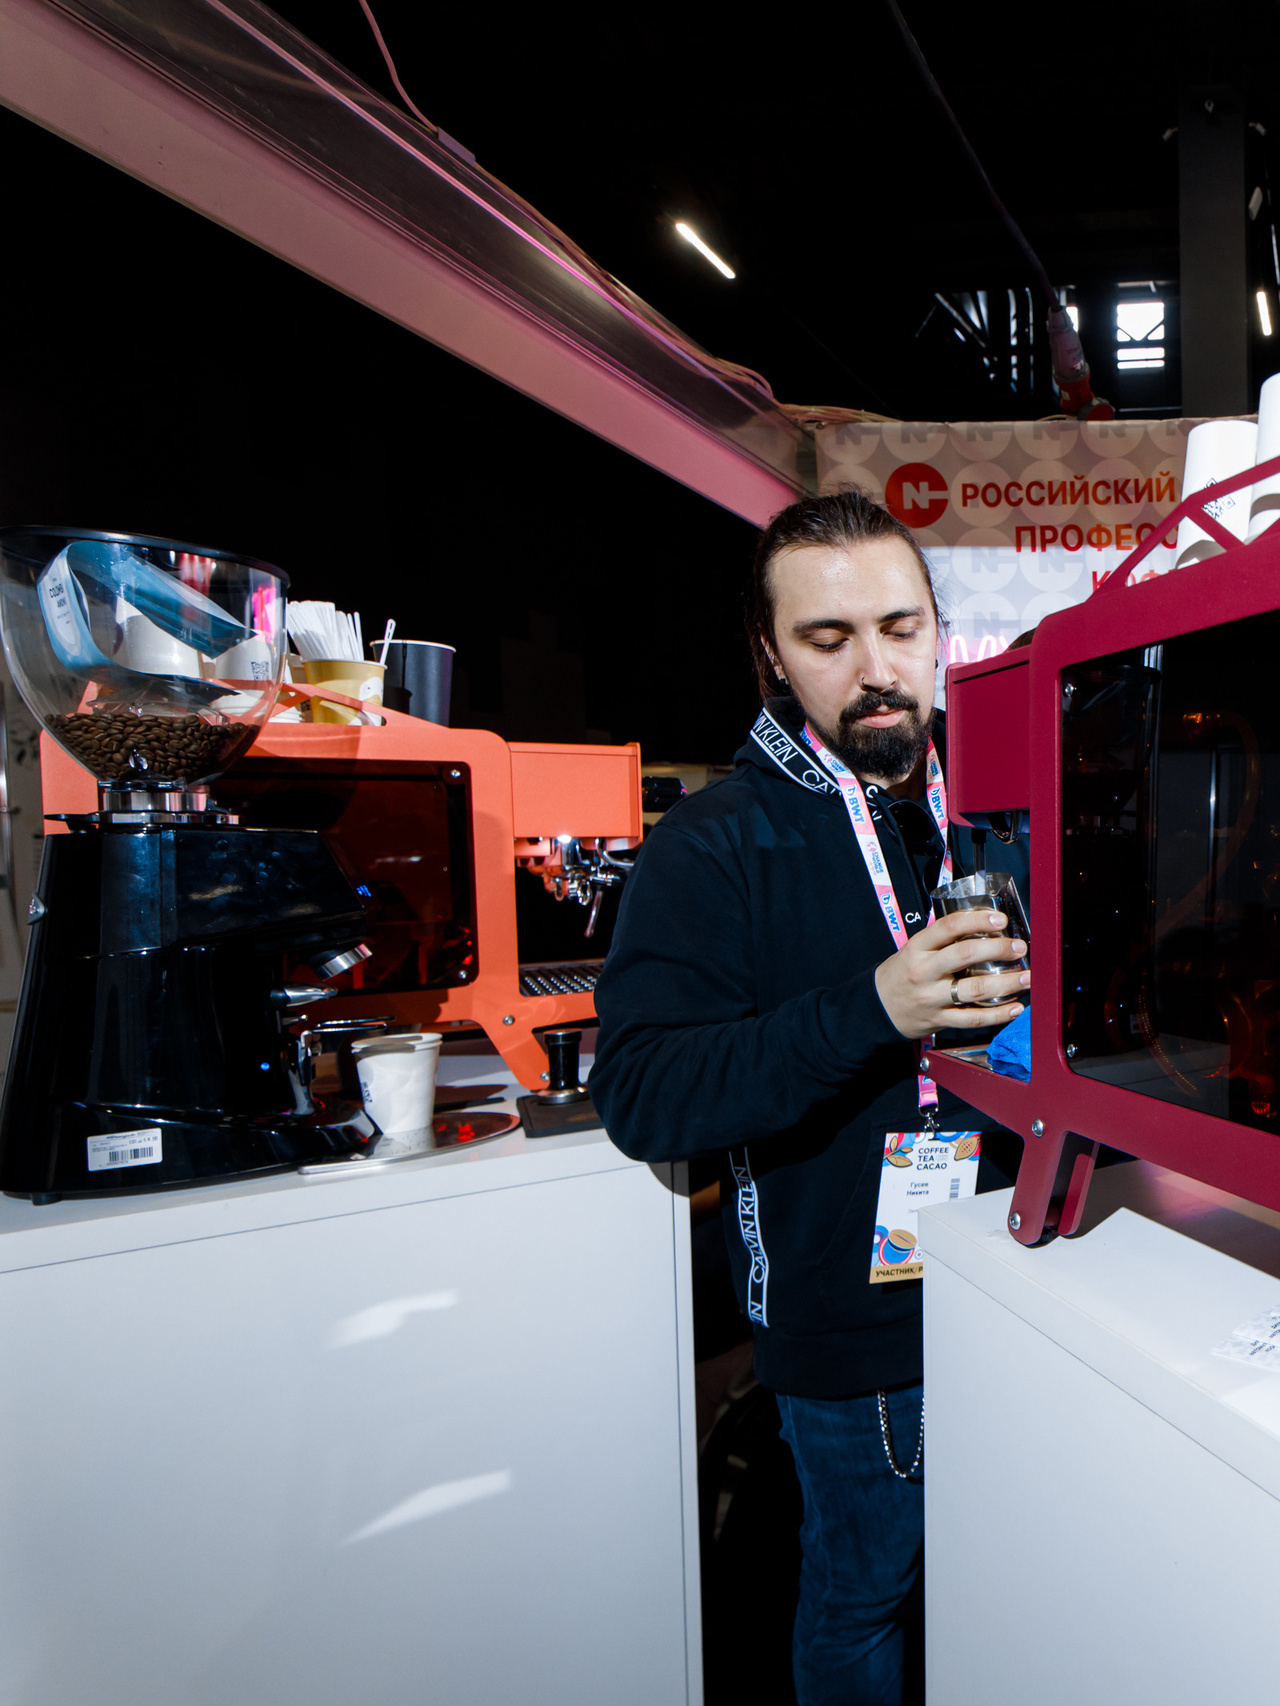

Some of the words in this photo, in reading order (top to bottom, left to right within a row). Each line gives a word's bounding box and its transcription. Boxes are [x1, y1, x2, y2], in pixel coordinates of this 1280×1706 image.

[961, 471, 1176, 508] РОССИЙСКИЙ
[759, 721, 799, 764] KLEIN
[848, 796, 865, 824] BWT
[931, 796, 945, 820] BWT
[884, 904, 901, 933] BWT
[918, 1146, 950, 1155] COFFEE
[916, 1162, 948, 1171] CACAO
[910, 1181, 929, 1189] Гусев
[742, 1220, 766, 1284] CALVIN
